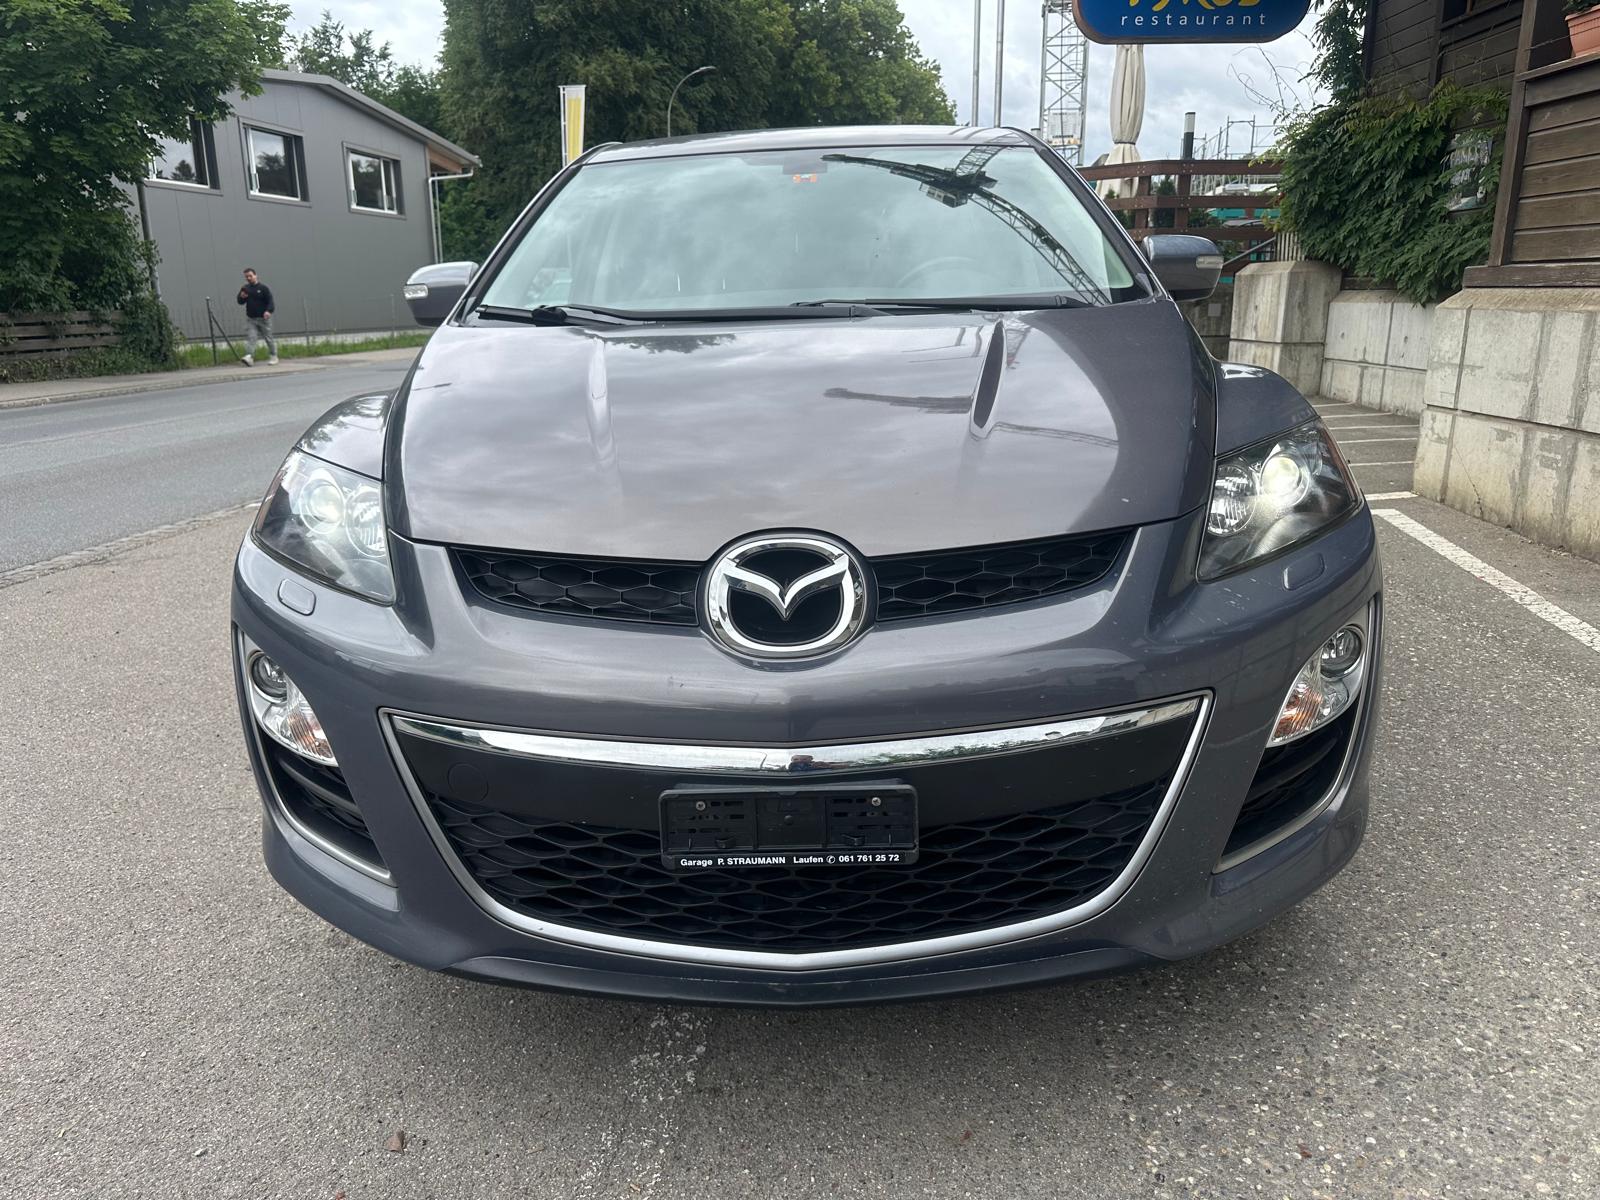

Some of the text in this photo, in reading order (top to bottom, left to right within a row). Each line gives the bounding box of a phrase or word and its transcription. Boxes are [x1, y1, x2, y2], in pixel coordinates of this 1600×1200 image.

[1120, 13, 1266, 26] restaurant
[680, 854, 900, 867] Garage P. STRAUMANN Laufen 061 761 25 72
